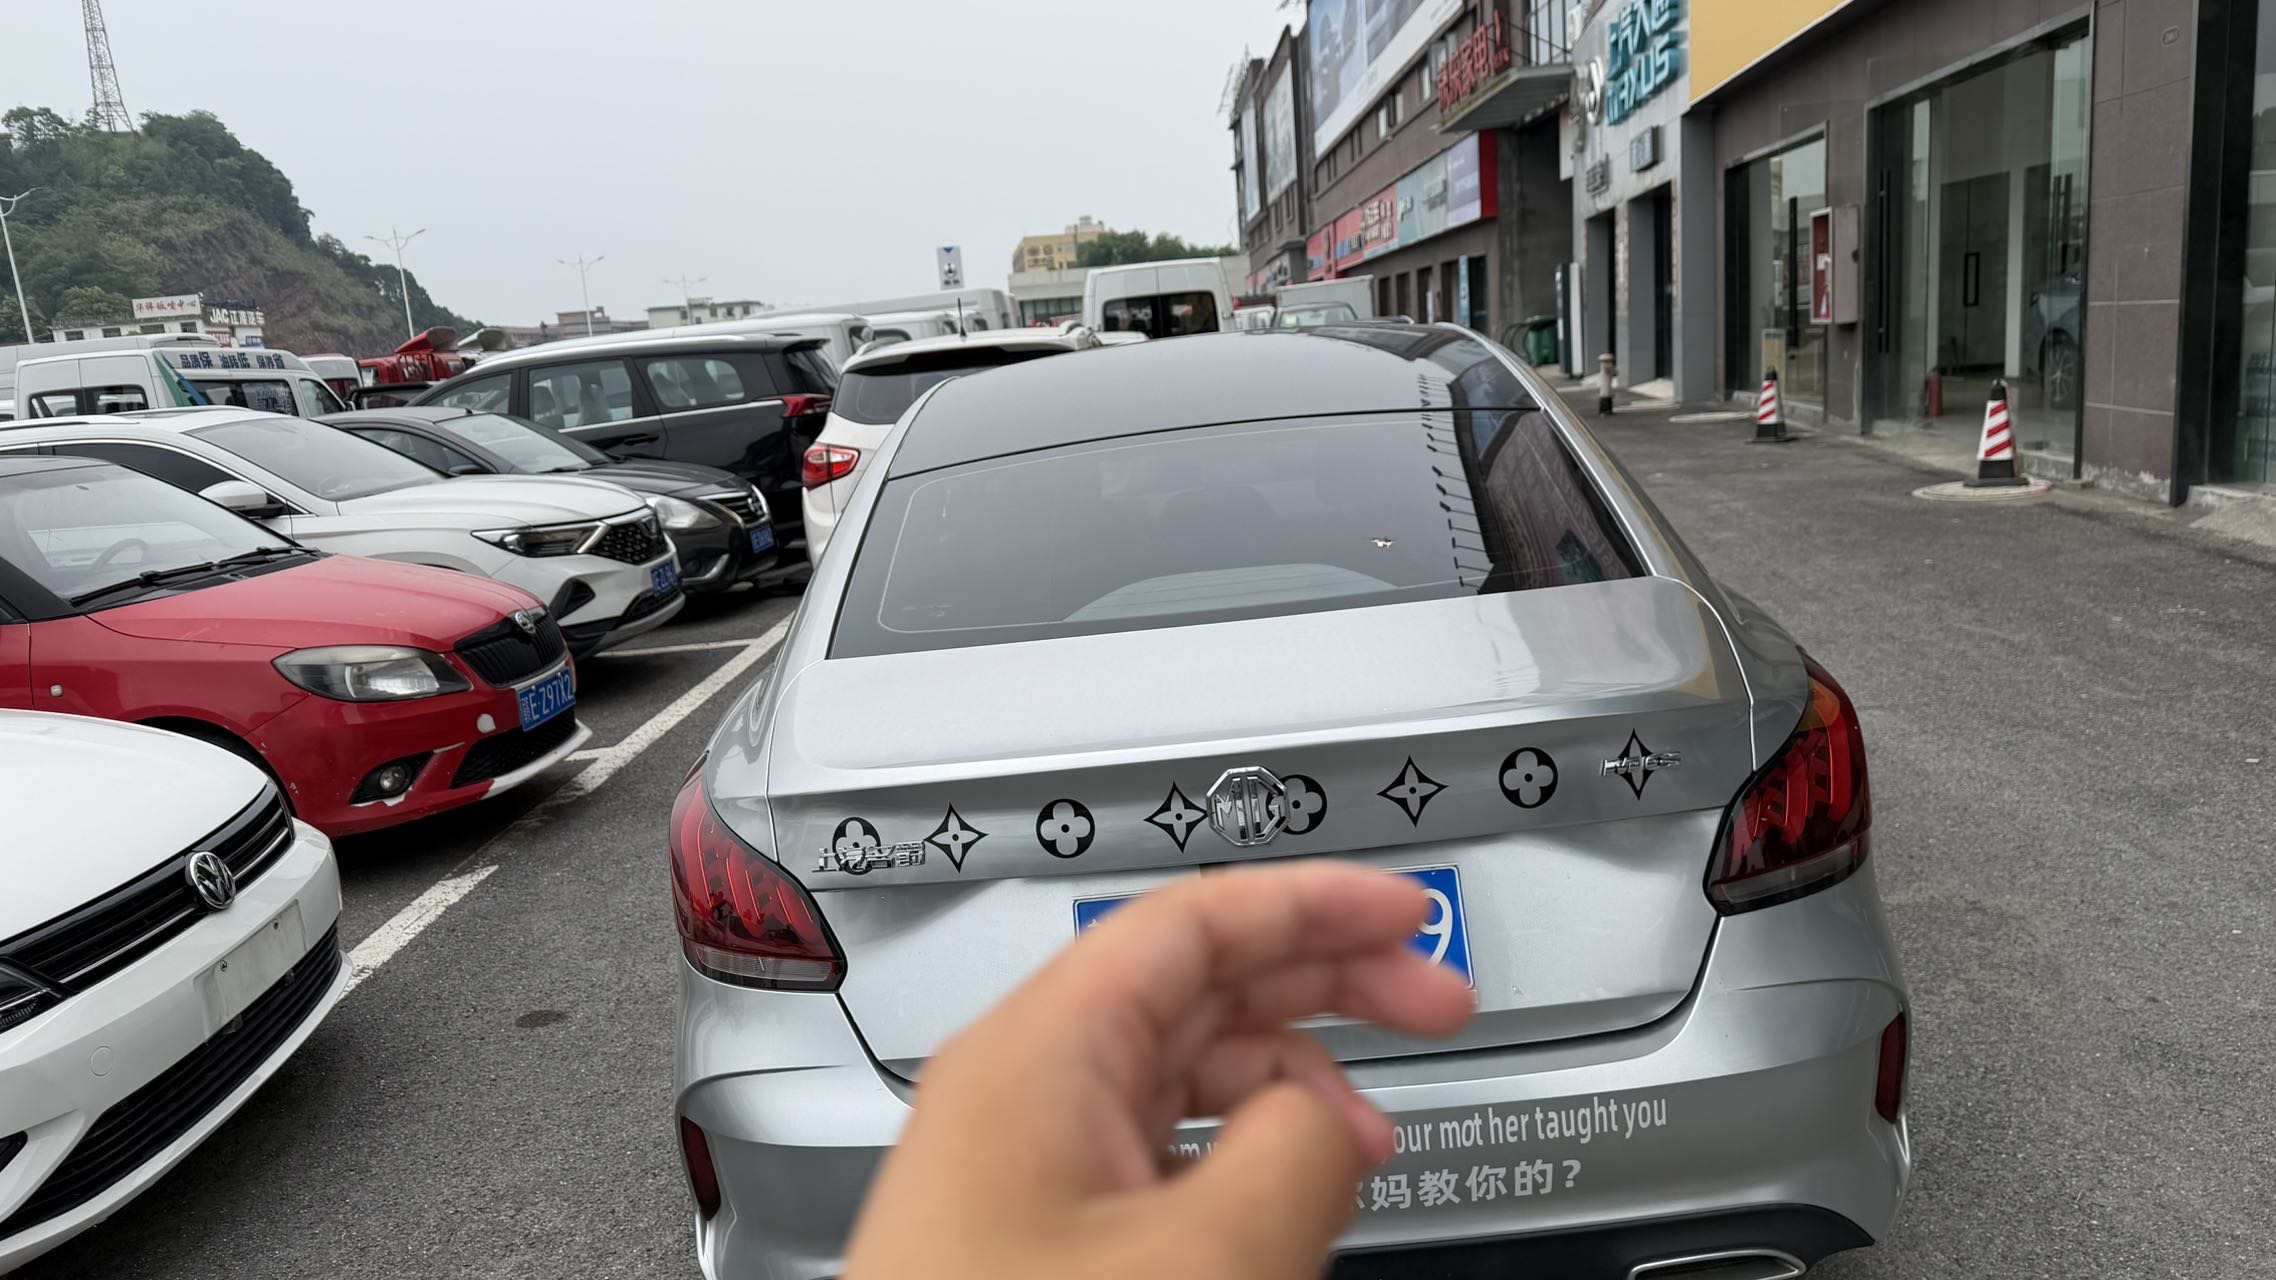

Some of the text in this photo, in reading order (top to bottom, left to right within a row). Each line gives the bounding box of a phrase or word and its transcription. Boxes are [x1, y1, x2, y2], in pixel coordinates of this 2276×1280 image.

[1388, 1122, 1432, 1157] our
[1535, 1096, 1619, 1144] taught
[1622, 1098, 1667, 1139] you
